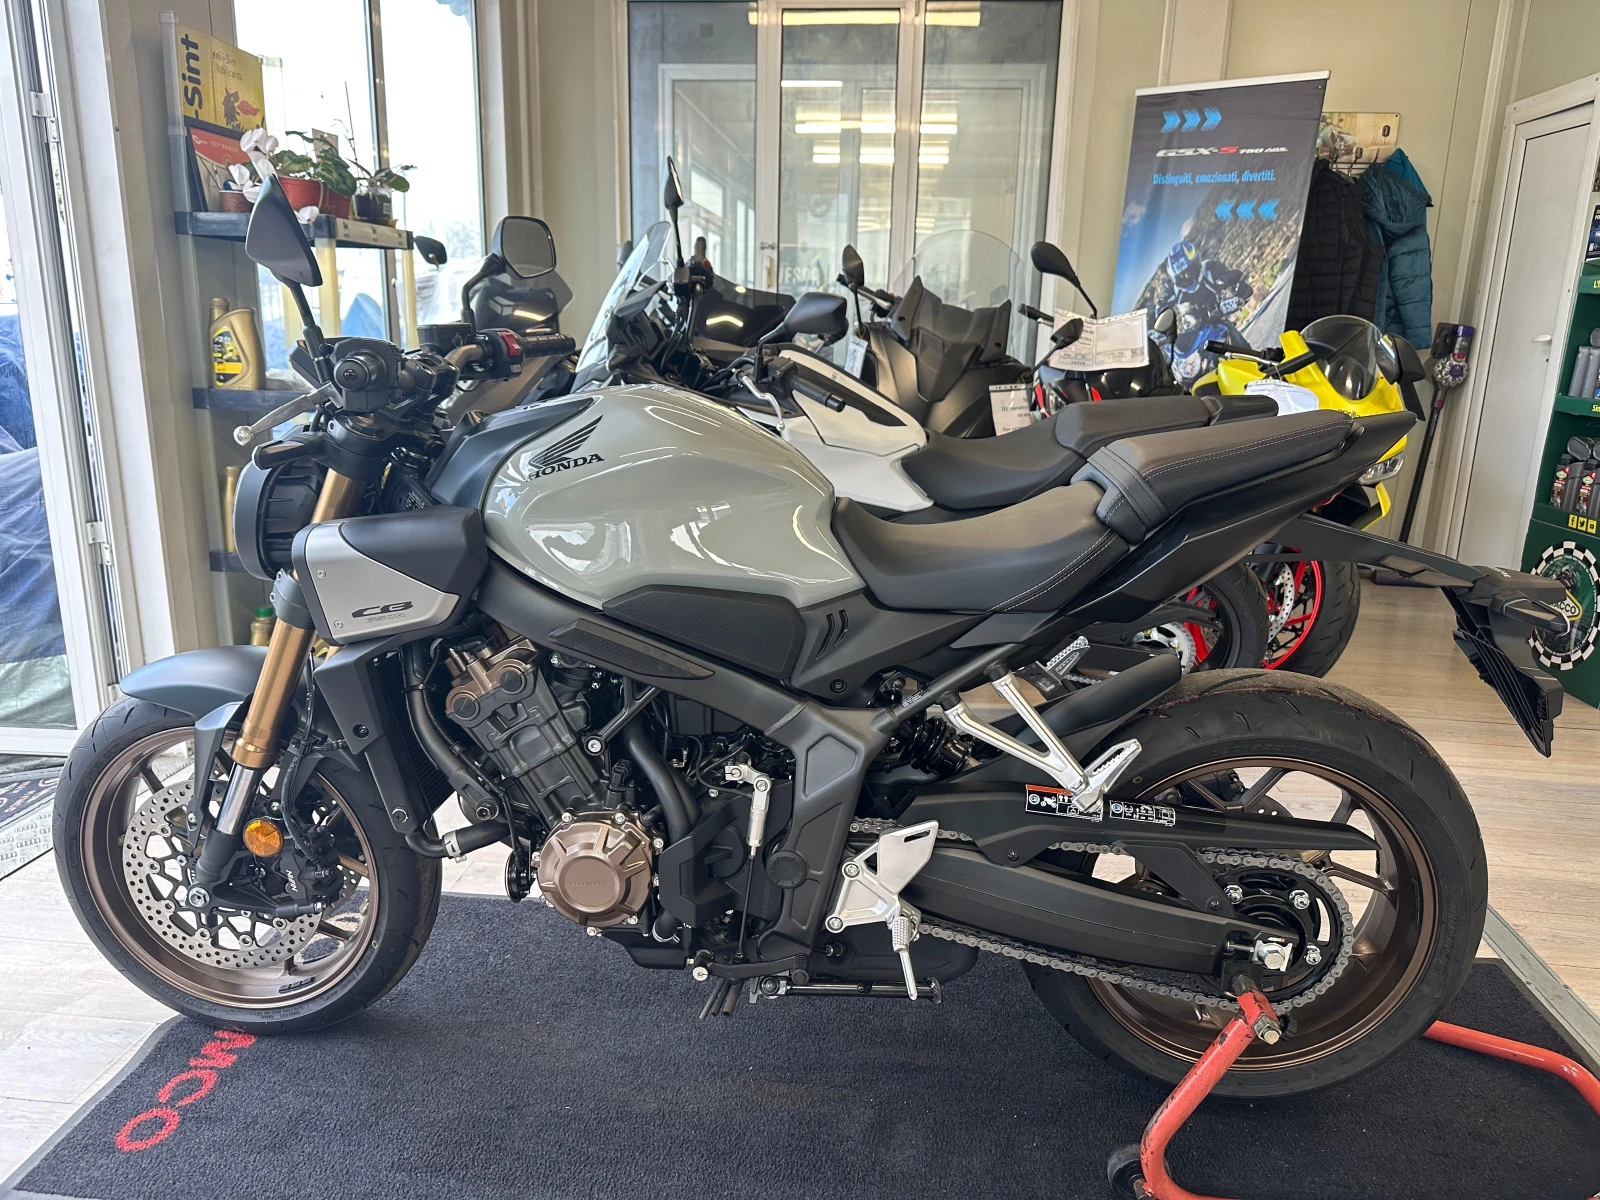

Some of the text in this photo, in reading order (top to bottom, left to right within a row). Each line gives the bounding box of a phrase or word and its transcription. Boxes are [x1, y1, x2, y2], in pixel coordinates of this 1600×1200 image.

[1156, 146, 1239, 157] GSX-S
[1152, 168, 1276, 187] Distinguiti, emozionati, divertiti.
[527, 453, 605, 481] HONDA
[351, 601, 413, 618] CB
